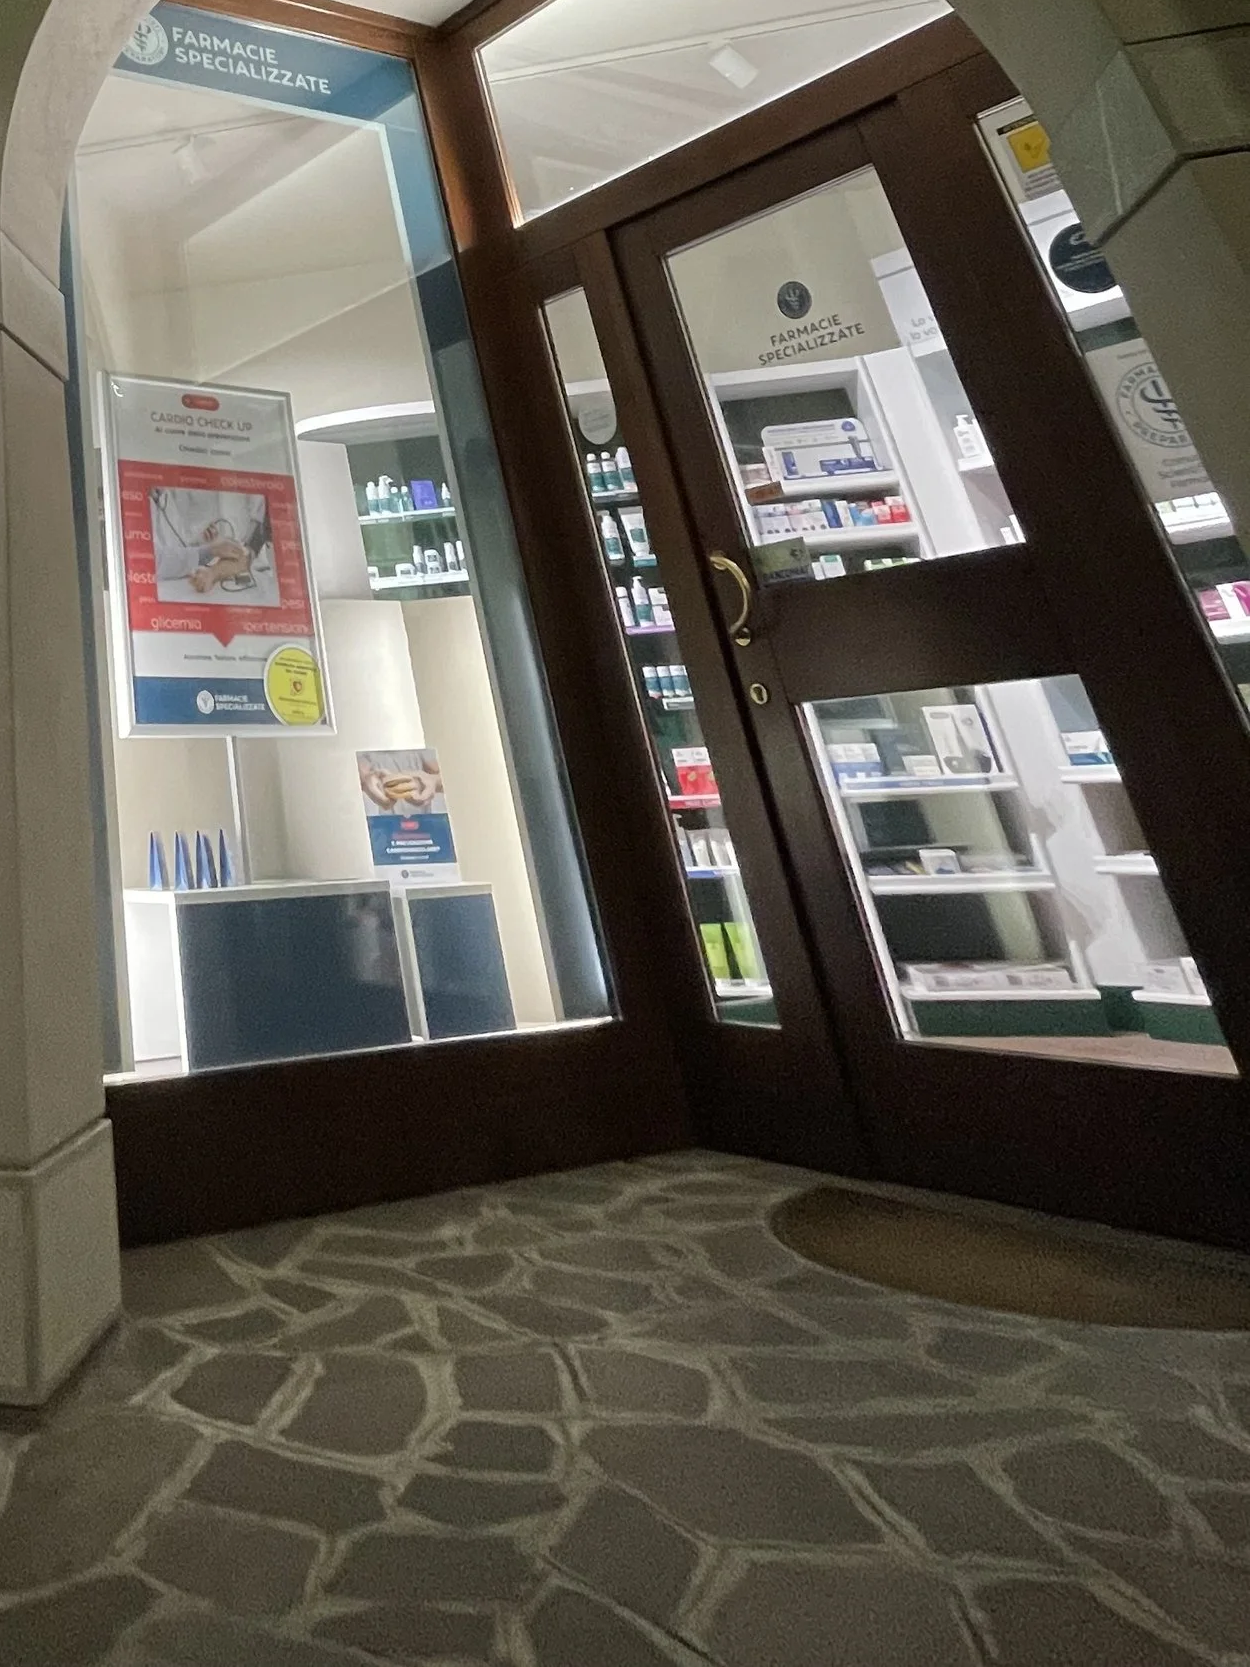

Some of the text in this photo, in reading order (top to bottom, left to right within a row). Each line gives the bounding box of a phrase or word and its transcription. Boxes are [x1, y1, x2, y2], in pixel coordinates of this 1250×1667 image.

[172, 26, 279, 66] FARMACIE
[174, 47, 332, 95] SPECIALIZZATE
[758, 323, 865, 366] SPECIALIZZATE
[770, 314, 841, 347] FARMACIE
[150, 411, 253, 432] CARDIO CHECK UP
[151, 615, 202, 632] glicemia
